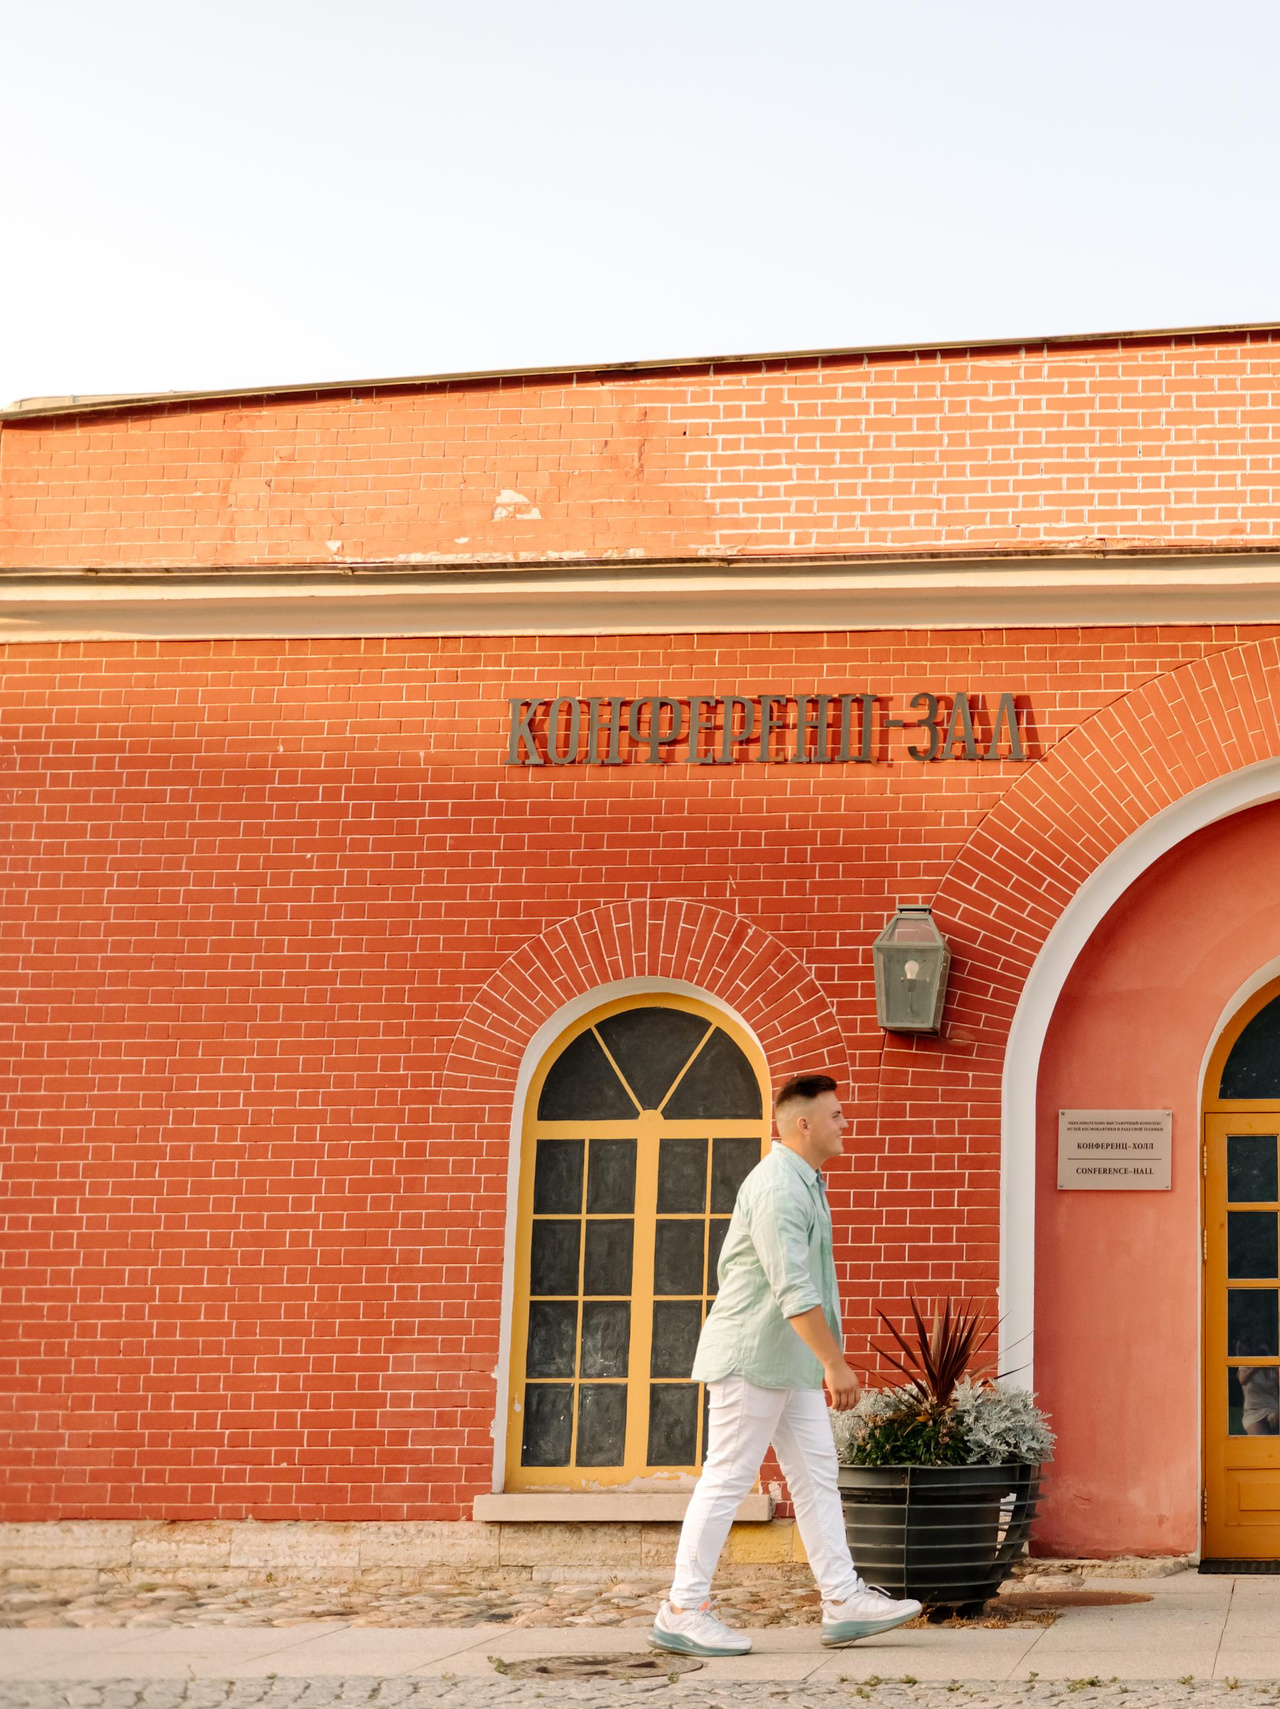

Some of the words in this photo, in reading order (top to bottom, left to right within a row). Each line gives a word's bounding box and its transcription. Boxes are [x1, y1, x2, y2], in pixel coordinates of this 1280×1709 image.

[504, 692, 1028, 766] КОНФЕРЕНЦ-ЗАЛ
[1077, 1142, 1154, 1151] КОНФЕРЕНЦ-ХОЛЛ
[1075, 1167, 1154, 1175] CONFERENCE-HALL
